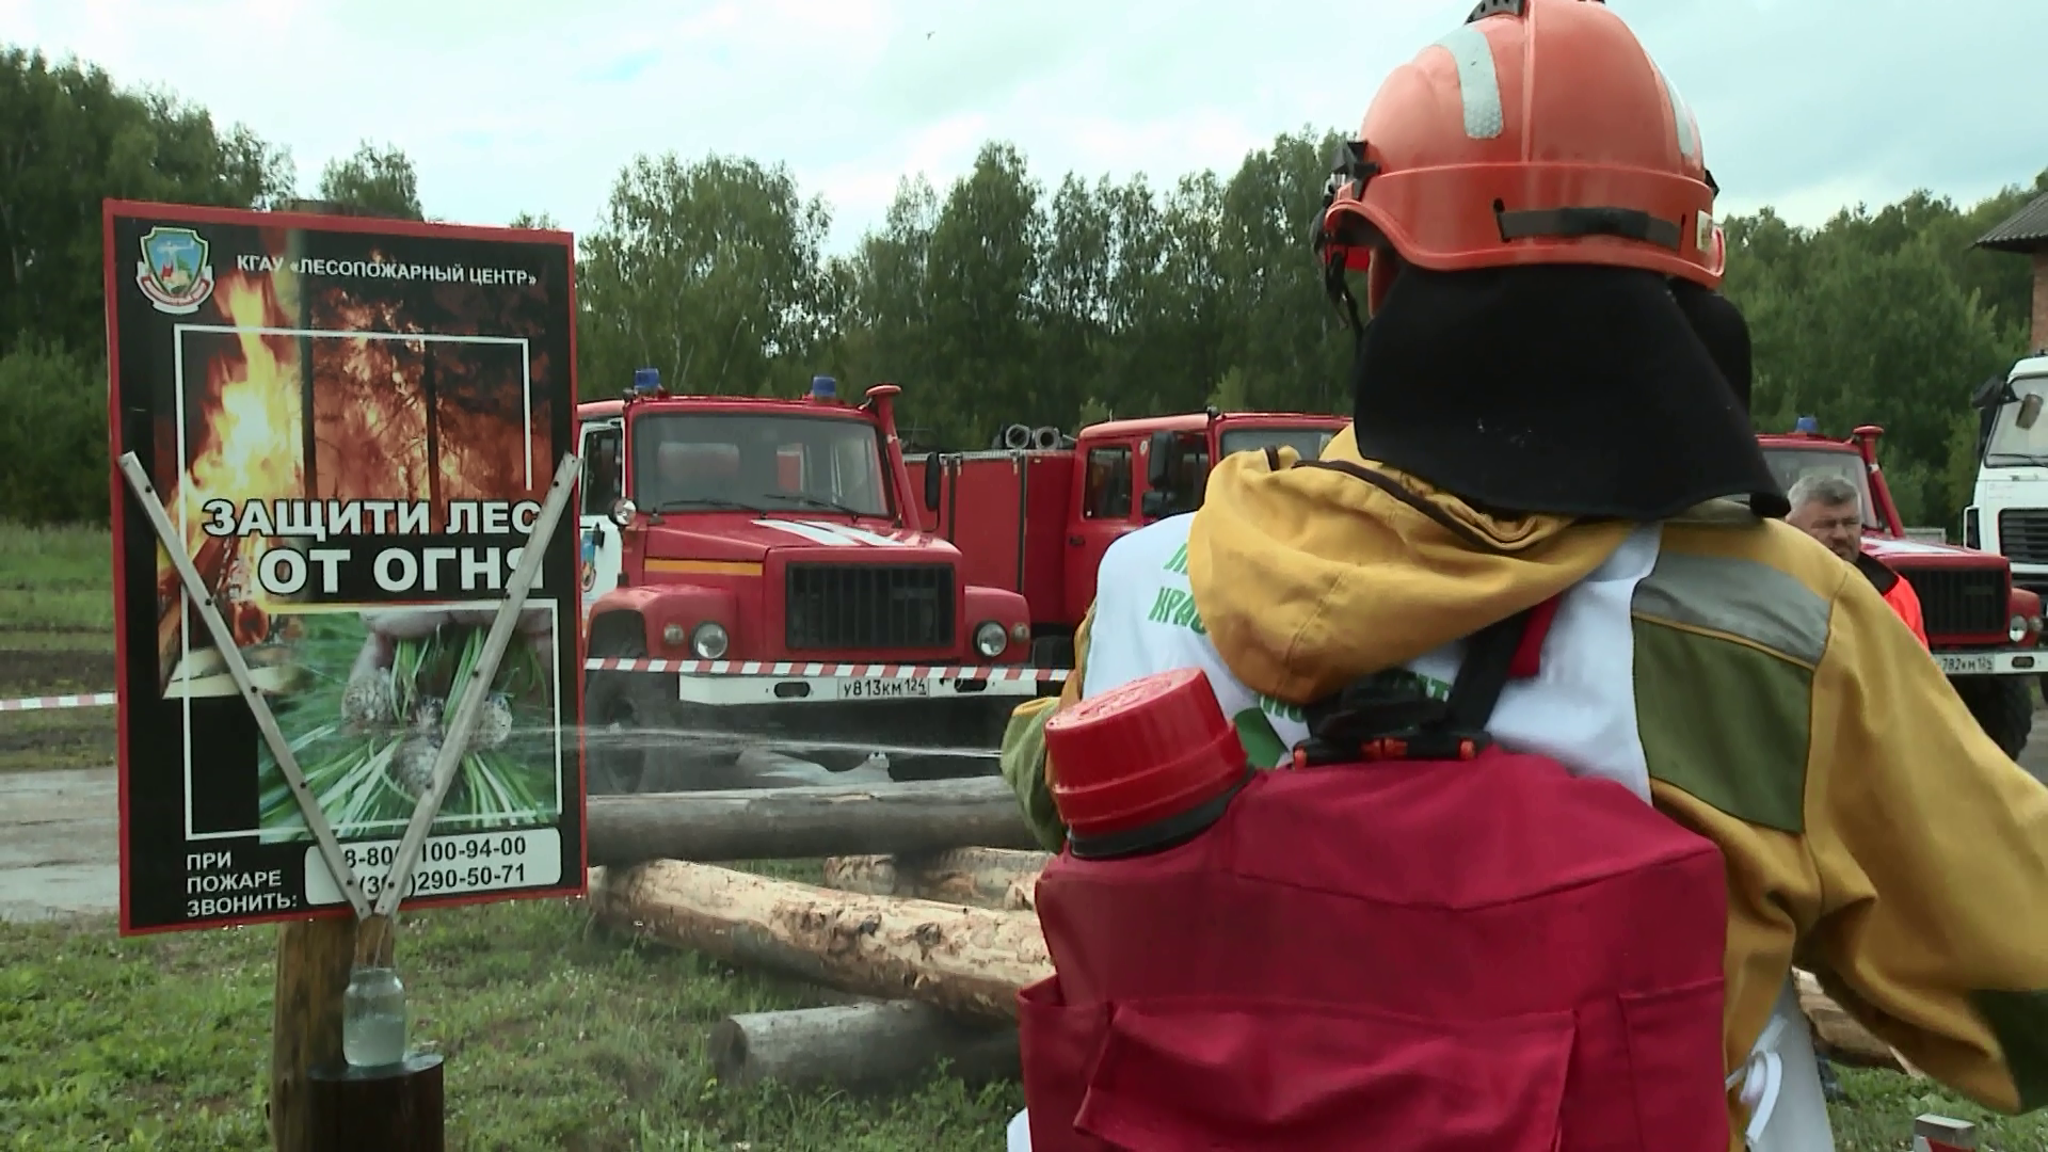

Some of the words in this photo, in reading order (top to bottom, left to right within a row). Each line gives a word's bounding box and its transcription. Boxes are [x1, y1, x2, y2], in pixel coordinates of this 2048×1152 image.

[237, 254, 284, 272] КГАУ
[290, 258, 465, 283] «ЛЕСОПОЖАРНЫЙ
[469, 265, 537, 287] ЦЕНТР»
[203, 499, 431, 542] ЗАЩИТИ
[446, 500, 543, 535] ЛЕС
[259, 547, 351, 594] ОТ
[186, 851, 232, 871] ПРИ
[186, 871, 283, 895] ПОЖАРЕ
[186, 894, 298, 919] ЗВОНИТЬ:
